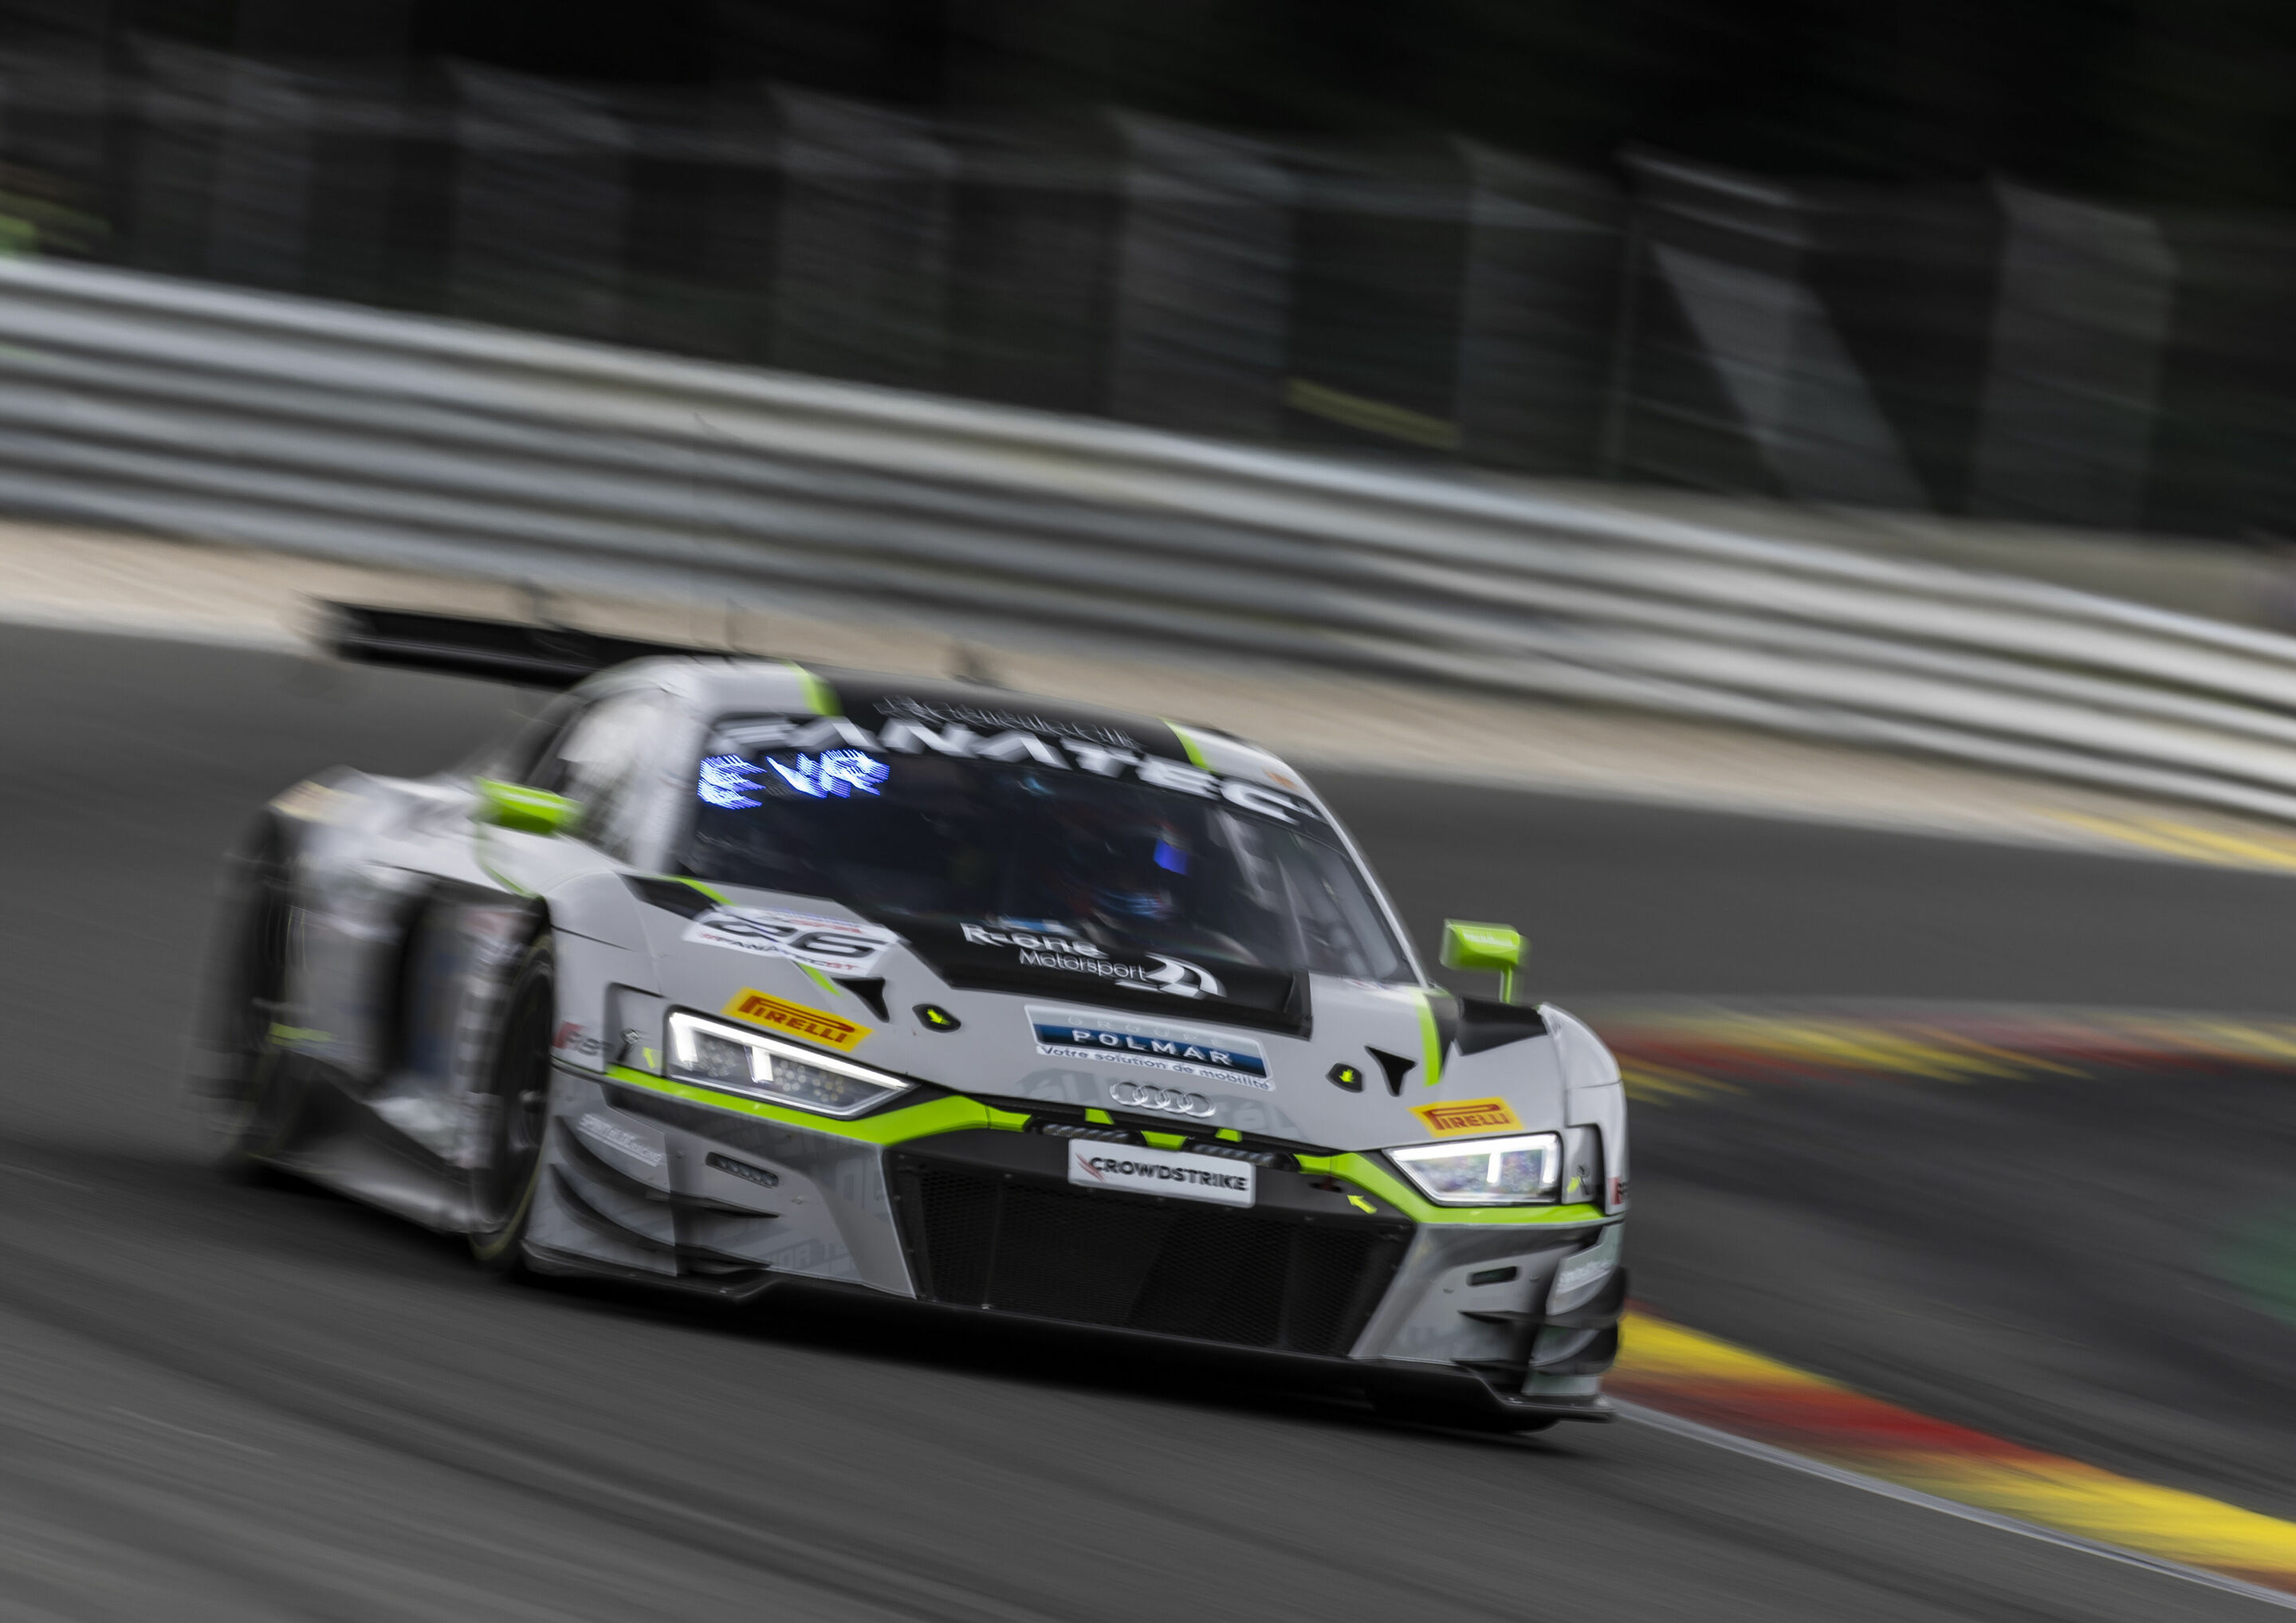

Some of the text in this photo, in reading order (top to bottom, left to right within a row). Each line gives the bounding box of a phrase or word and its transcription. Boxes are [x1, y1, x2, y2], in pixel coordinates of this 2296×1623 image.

[710, 715, 1304, 826] FANATEC
[1018, 948, 1146, 981] Motorsport
[737, 995, 856, 1043] PIRELLI
[1040, 1045, 1089, 1060] Votre
[1095, 1052, 1167, 1071] solution
[1172, 1062, 1194, 1074] de
[1072, 1029, 1234, 1067] POLMAR
[1420, 1103, 1512, 1130] PIRELLI
[1089, 1157, 1248, 1191] CROWDSTRIKE
